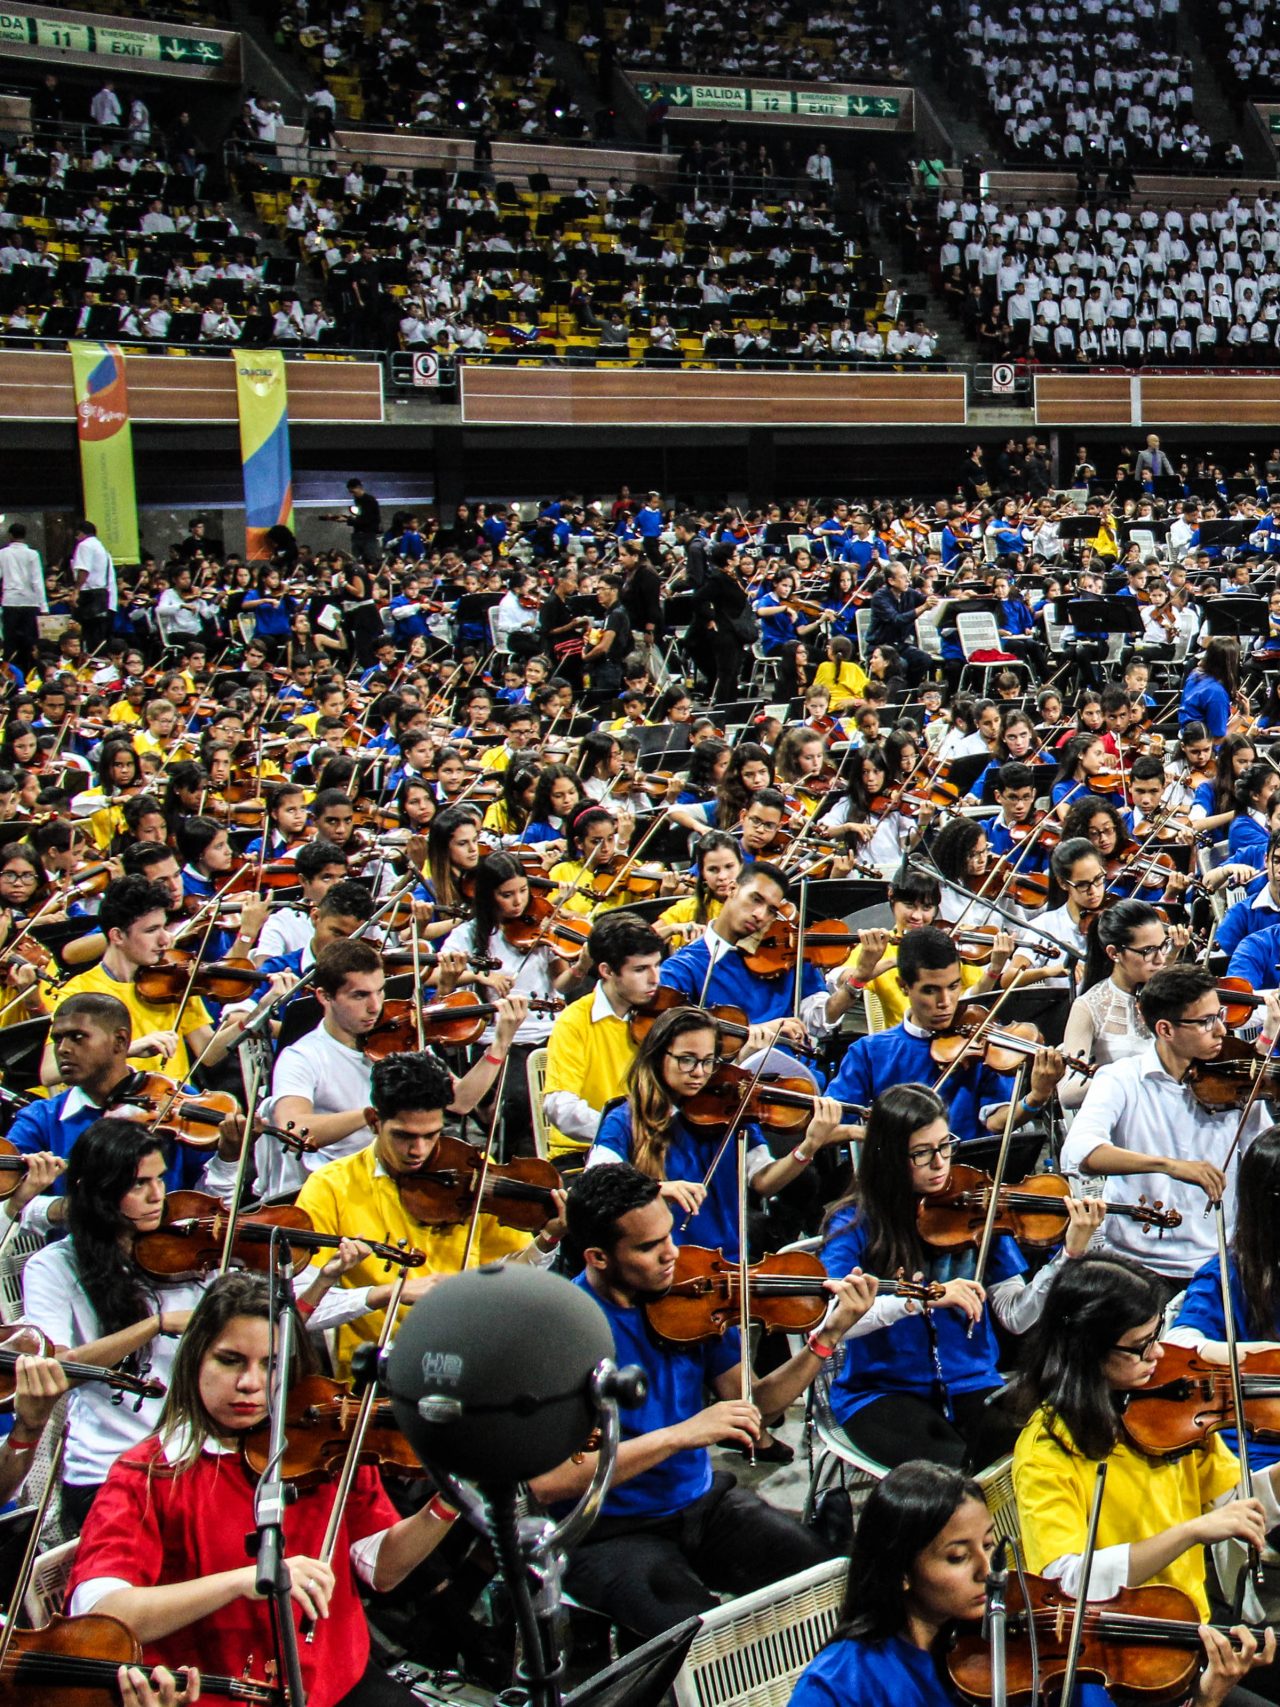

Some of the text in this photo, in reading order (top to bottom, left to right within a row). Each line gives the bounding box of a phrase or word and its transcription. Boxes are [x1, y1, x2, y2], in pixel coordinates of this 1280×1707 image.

[51, 30, 72, 47] 11
[111, 41, 144, 56] EXIT
[696, 88, 742, 100] SALIDA
[801, 93, 842, 101] EMERGENCY
[696, 100, 742, 109] EMERGENCIA
[763, 97, 780, 111] 12
[809, 103, 834, 114] EXIT
